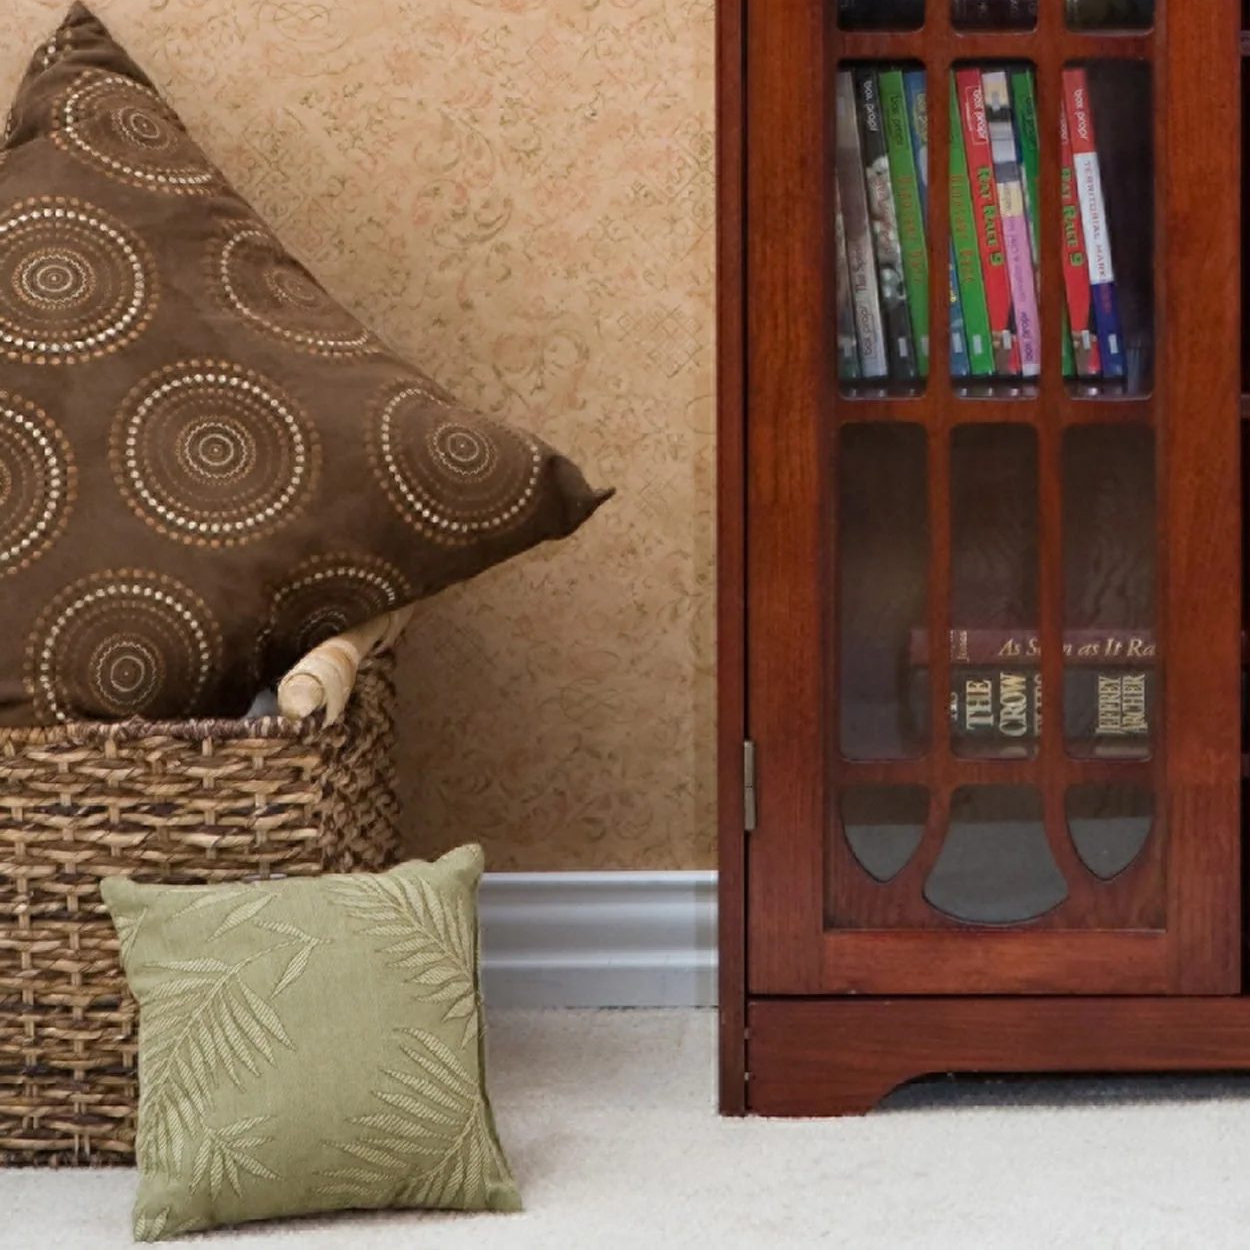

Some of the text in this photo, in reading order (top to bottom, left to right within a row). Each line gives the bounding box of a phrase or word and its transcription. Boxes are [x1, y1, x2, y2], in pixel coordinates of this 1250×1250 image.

[864, 80, 873, 100] box
[972, 89, 988, 141] box props
[1074, 89, 1089, 142] box props
[1084, 160, 1100, 240] TERRITORIAL
[999, 638, 1020, 656] As
[1077, 643, 1101, 657] as
[1104, 638, 1122, 657] It
[966, 679, 994, 730] THE
[999, 672, 1027, 737] CROW
[1095, 675, 1121, 735] JEFFREY
[1121, 674, 1148, 734] ARCHER
